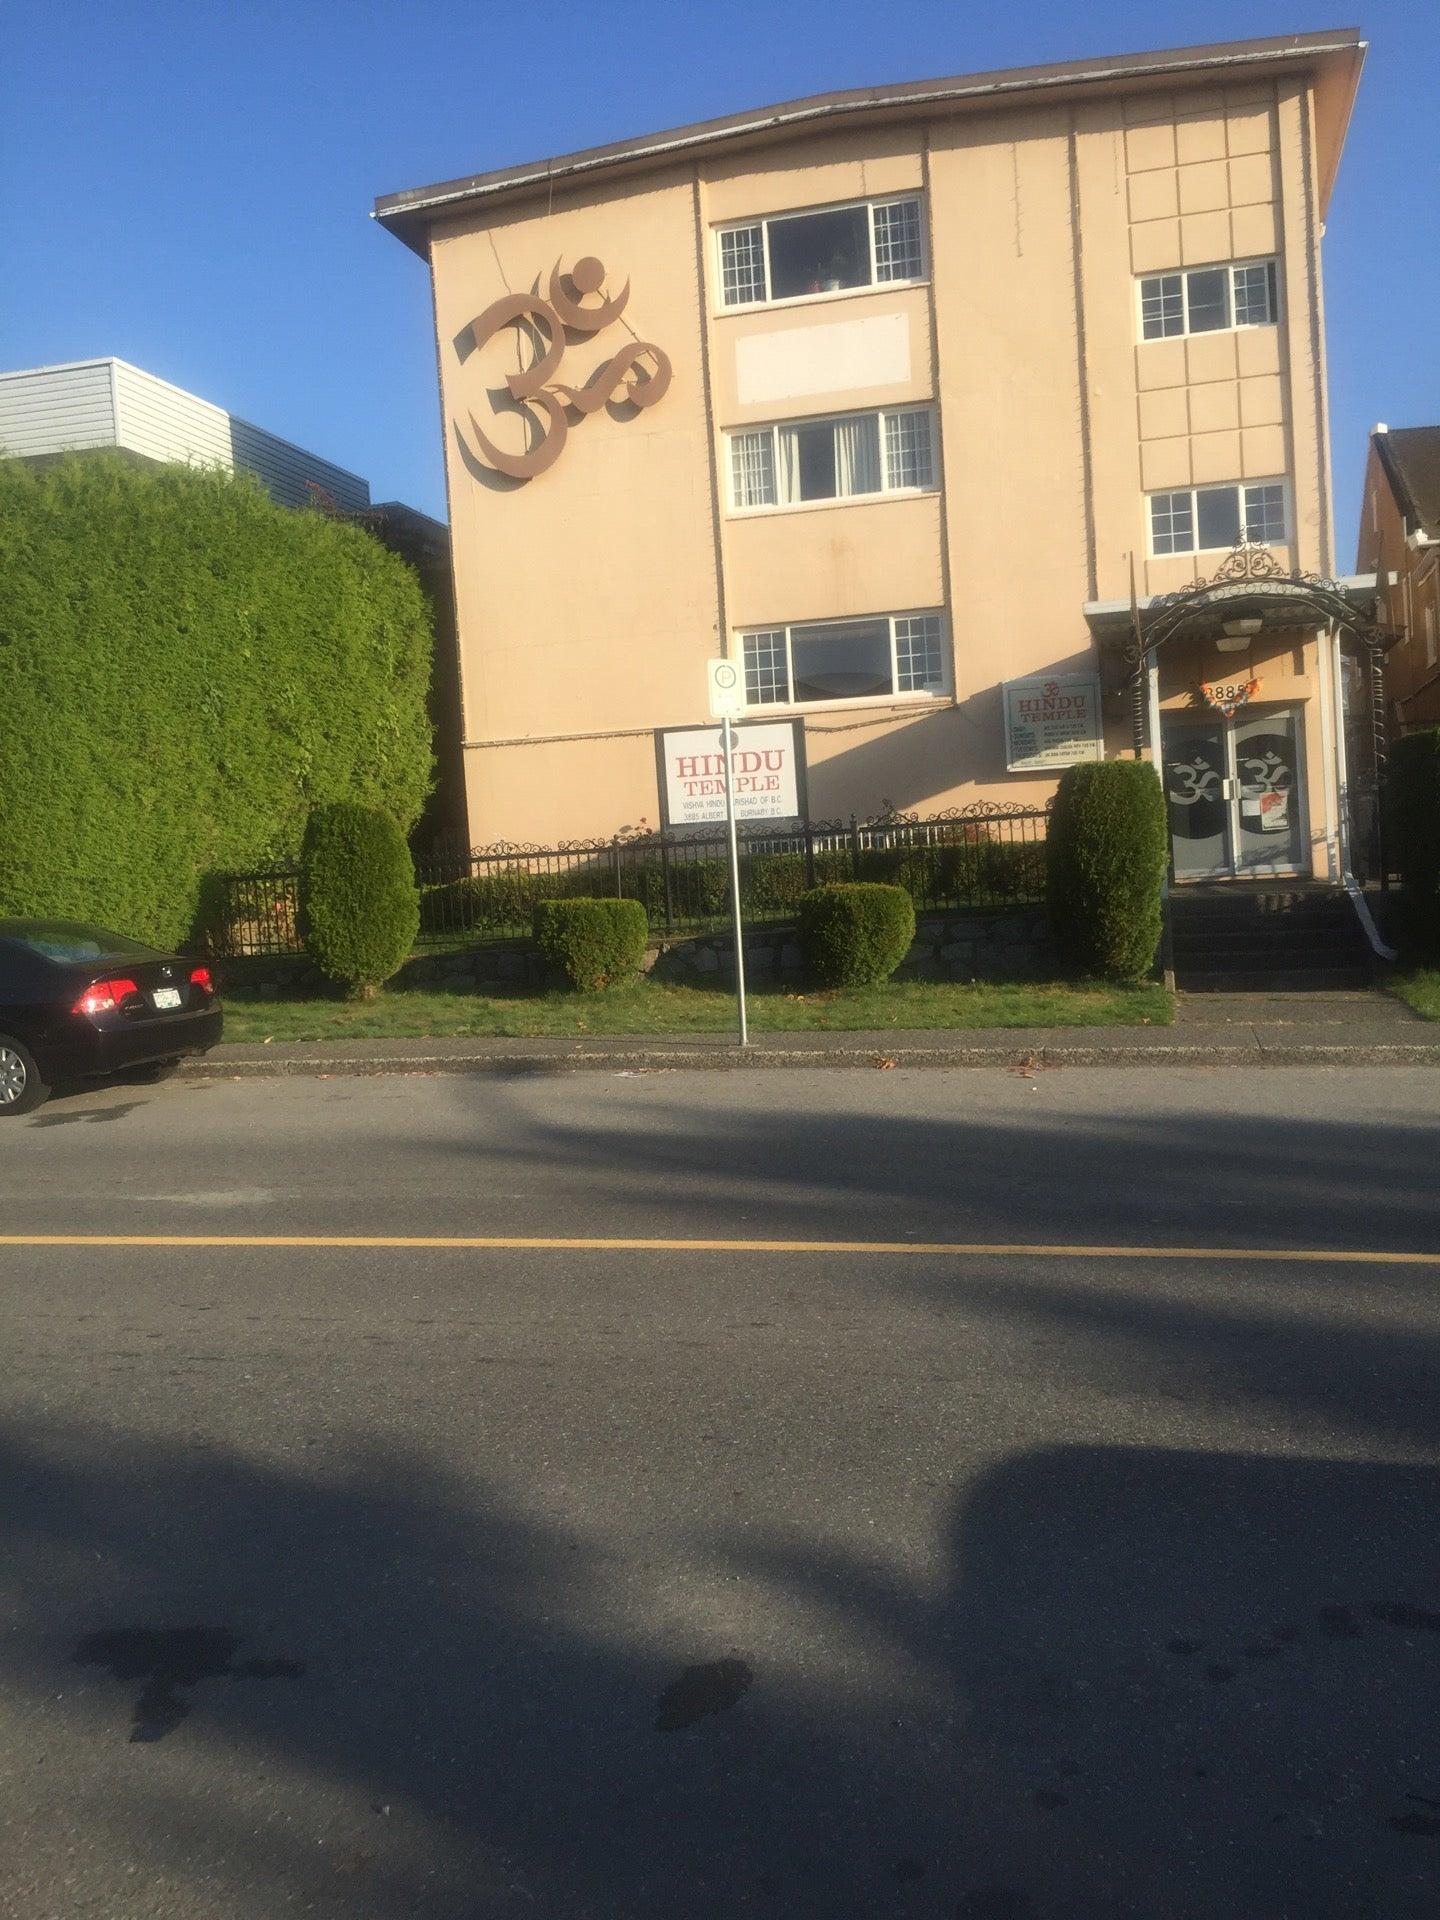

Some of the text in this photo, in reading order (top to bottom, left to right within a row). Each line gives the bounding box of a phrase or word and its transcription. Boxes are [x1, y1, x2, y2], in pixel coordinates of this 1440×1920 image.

[1018, 696, 1086, 712] HINDU
[1020, 708, 1086, 723] TEMPLE
[675, 749, 785, 778] HINDU
[707, 799, 725, 808] HINDU
[733, 797, 757, 806] RISHAD
[761, 796, 769, 804] OF
[702, 811, 724, 819] ALBERT
[741, 808, 768, 817] BURNABY
